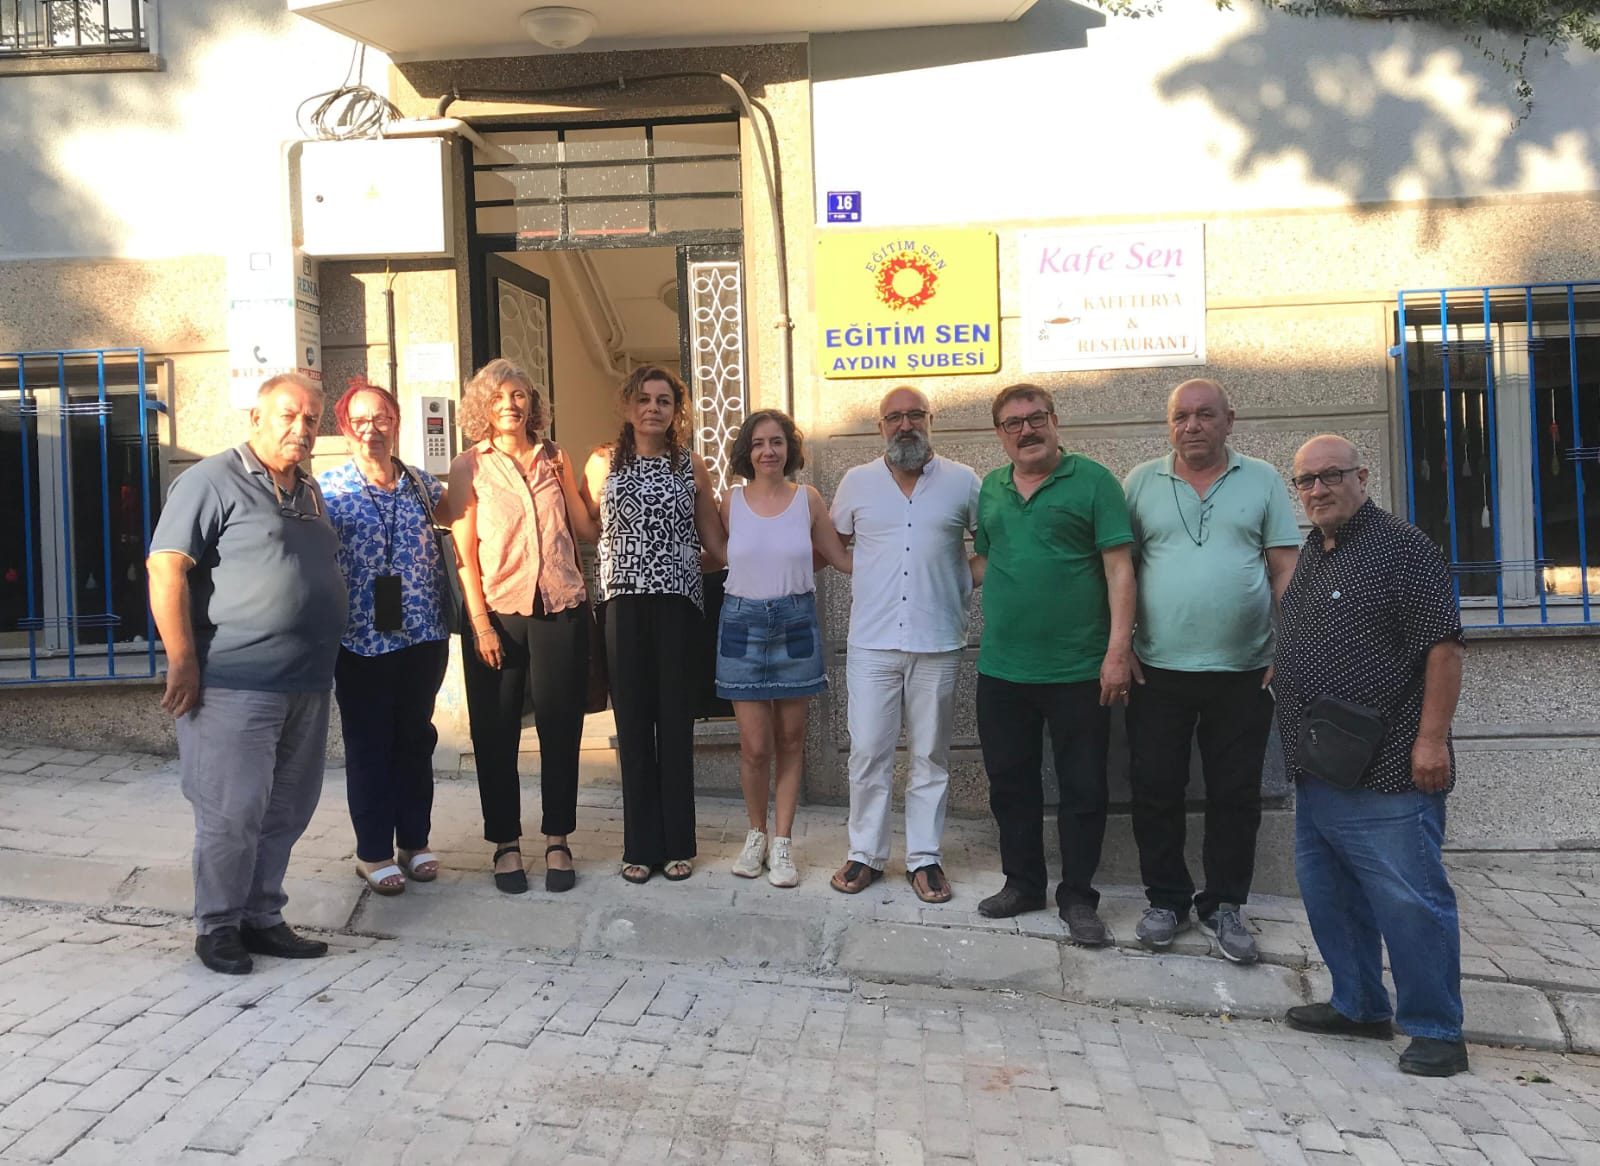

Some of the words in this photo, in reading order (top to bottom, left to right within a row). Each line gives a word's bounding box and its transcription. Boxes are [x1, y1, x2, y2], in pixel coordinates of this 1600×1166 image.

[836, 195, 853, 210] 16
[865, 238, 915, 273] EĞİTİM
[920, 243, 947, 271] SEN
[1039, 245, 1115, 275] Kafe
[1125, 241, 1184, 270] Sen
[1083, 292, 1182, 310] KAFETERYA
[1127, 317, 1138, 329] &
[826, 321, 925, 348] EĞİTİM
[935, 323, 991, 344] SEN
[1078, 335, 1189, 353] RESTAURANT
[833, 355, 896, 371] AYDIN
[907, 348, 985, 371] ŞUBESİ
